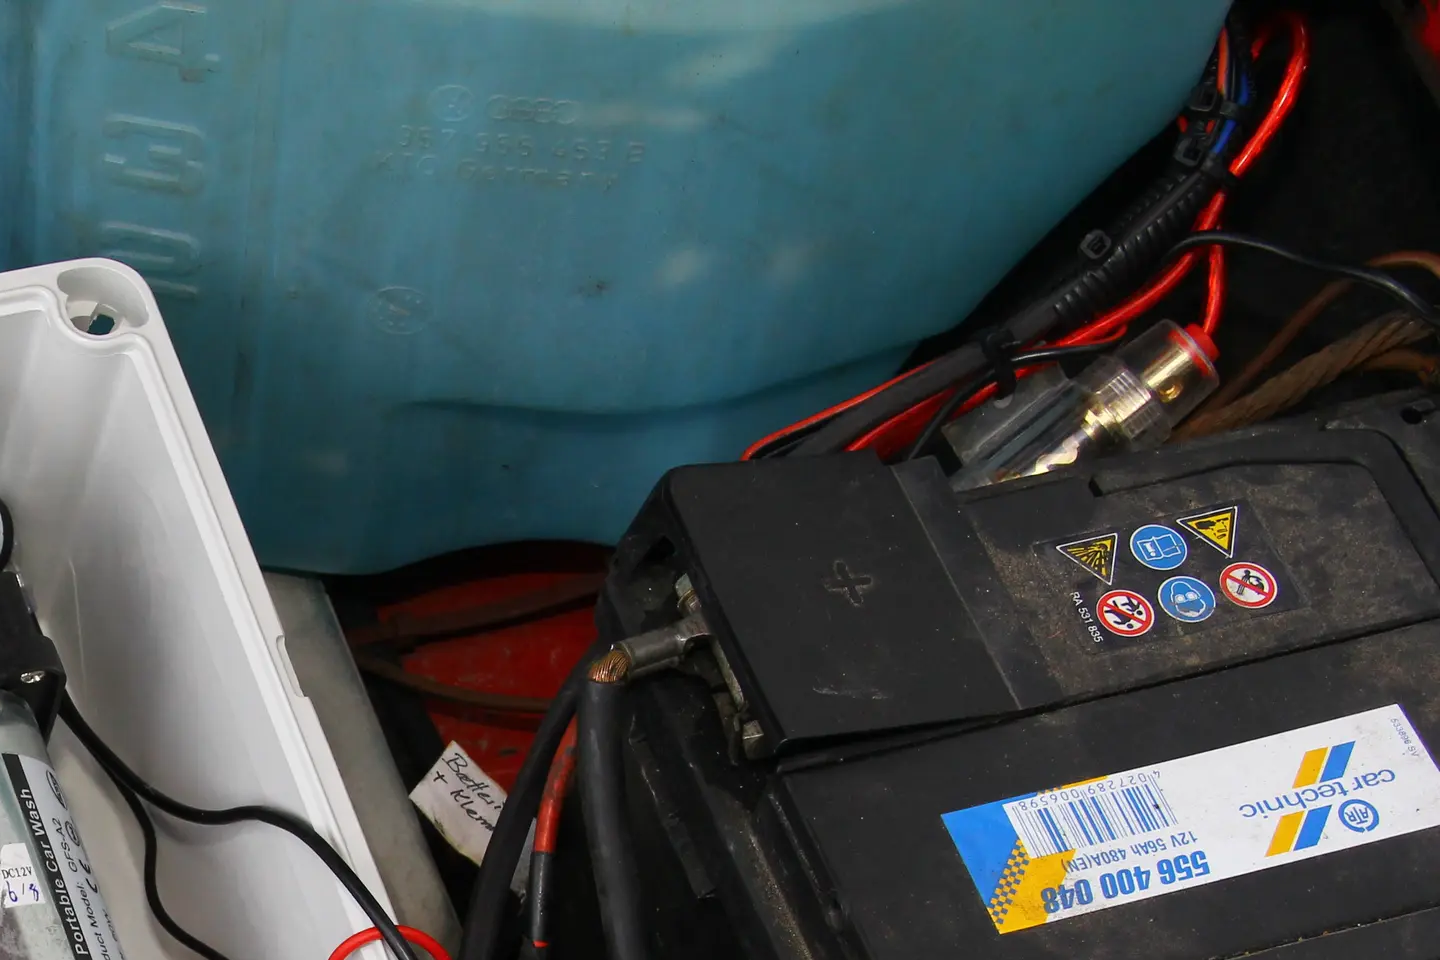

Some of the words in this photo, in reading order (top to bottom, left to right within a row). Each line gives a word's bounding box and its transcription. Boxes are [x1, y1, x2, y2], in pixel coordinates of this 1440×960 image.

[1078, 607, 1093, 624] 531
[1088, 625, 1104, 643] 835
[20, 788, 45, 837] Wash
[46, 841, 61, 873] Car
[1130, 840, 1168, 857] 56Ah
[1172, 830, 1198, 849] 12V
[1, 866, 33, 880] DC12V
[1060, 847, 1128, 874] 480A(EN)
[1156, 850, 1210, 885] 556
[1041, 878, 1094, 914] 048
[1099, 865, 1152, 900] 400
[55, 878, 89, 955] Portable
[76, 882, 98, 929] Model:
